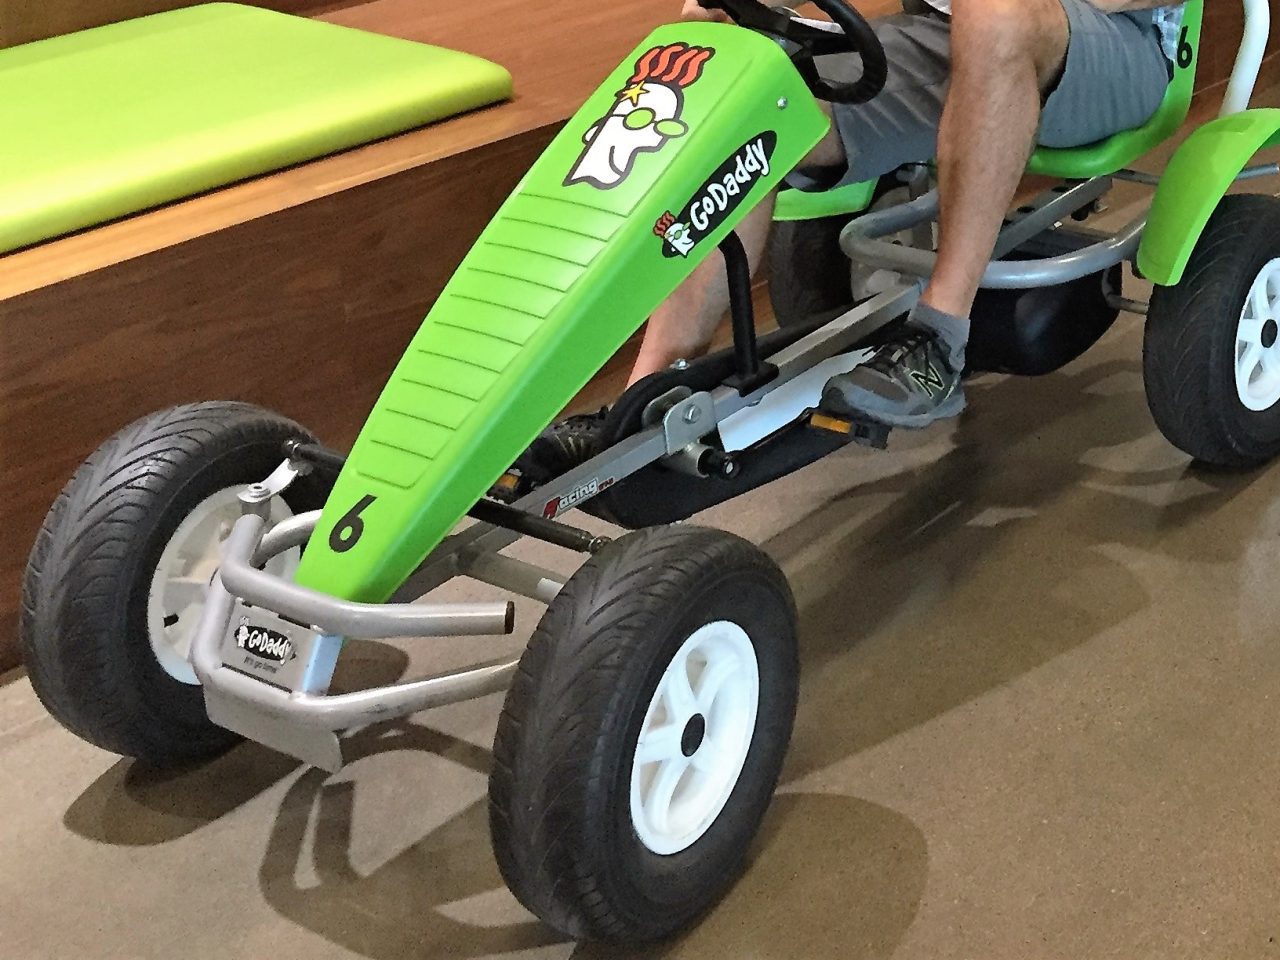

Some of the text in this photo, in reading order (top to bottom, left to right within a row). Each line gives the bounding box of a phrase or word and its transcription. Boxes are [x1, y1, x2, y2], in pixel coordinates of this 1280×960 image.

[1177, 25, 1193, 69] 6
[690, 138, 771, 231] GoDaddy
[328, 494, 378, 553] 6
[247, 630, 292, 665] GoDaddy
